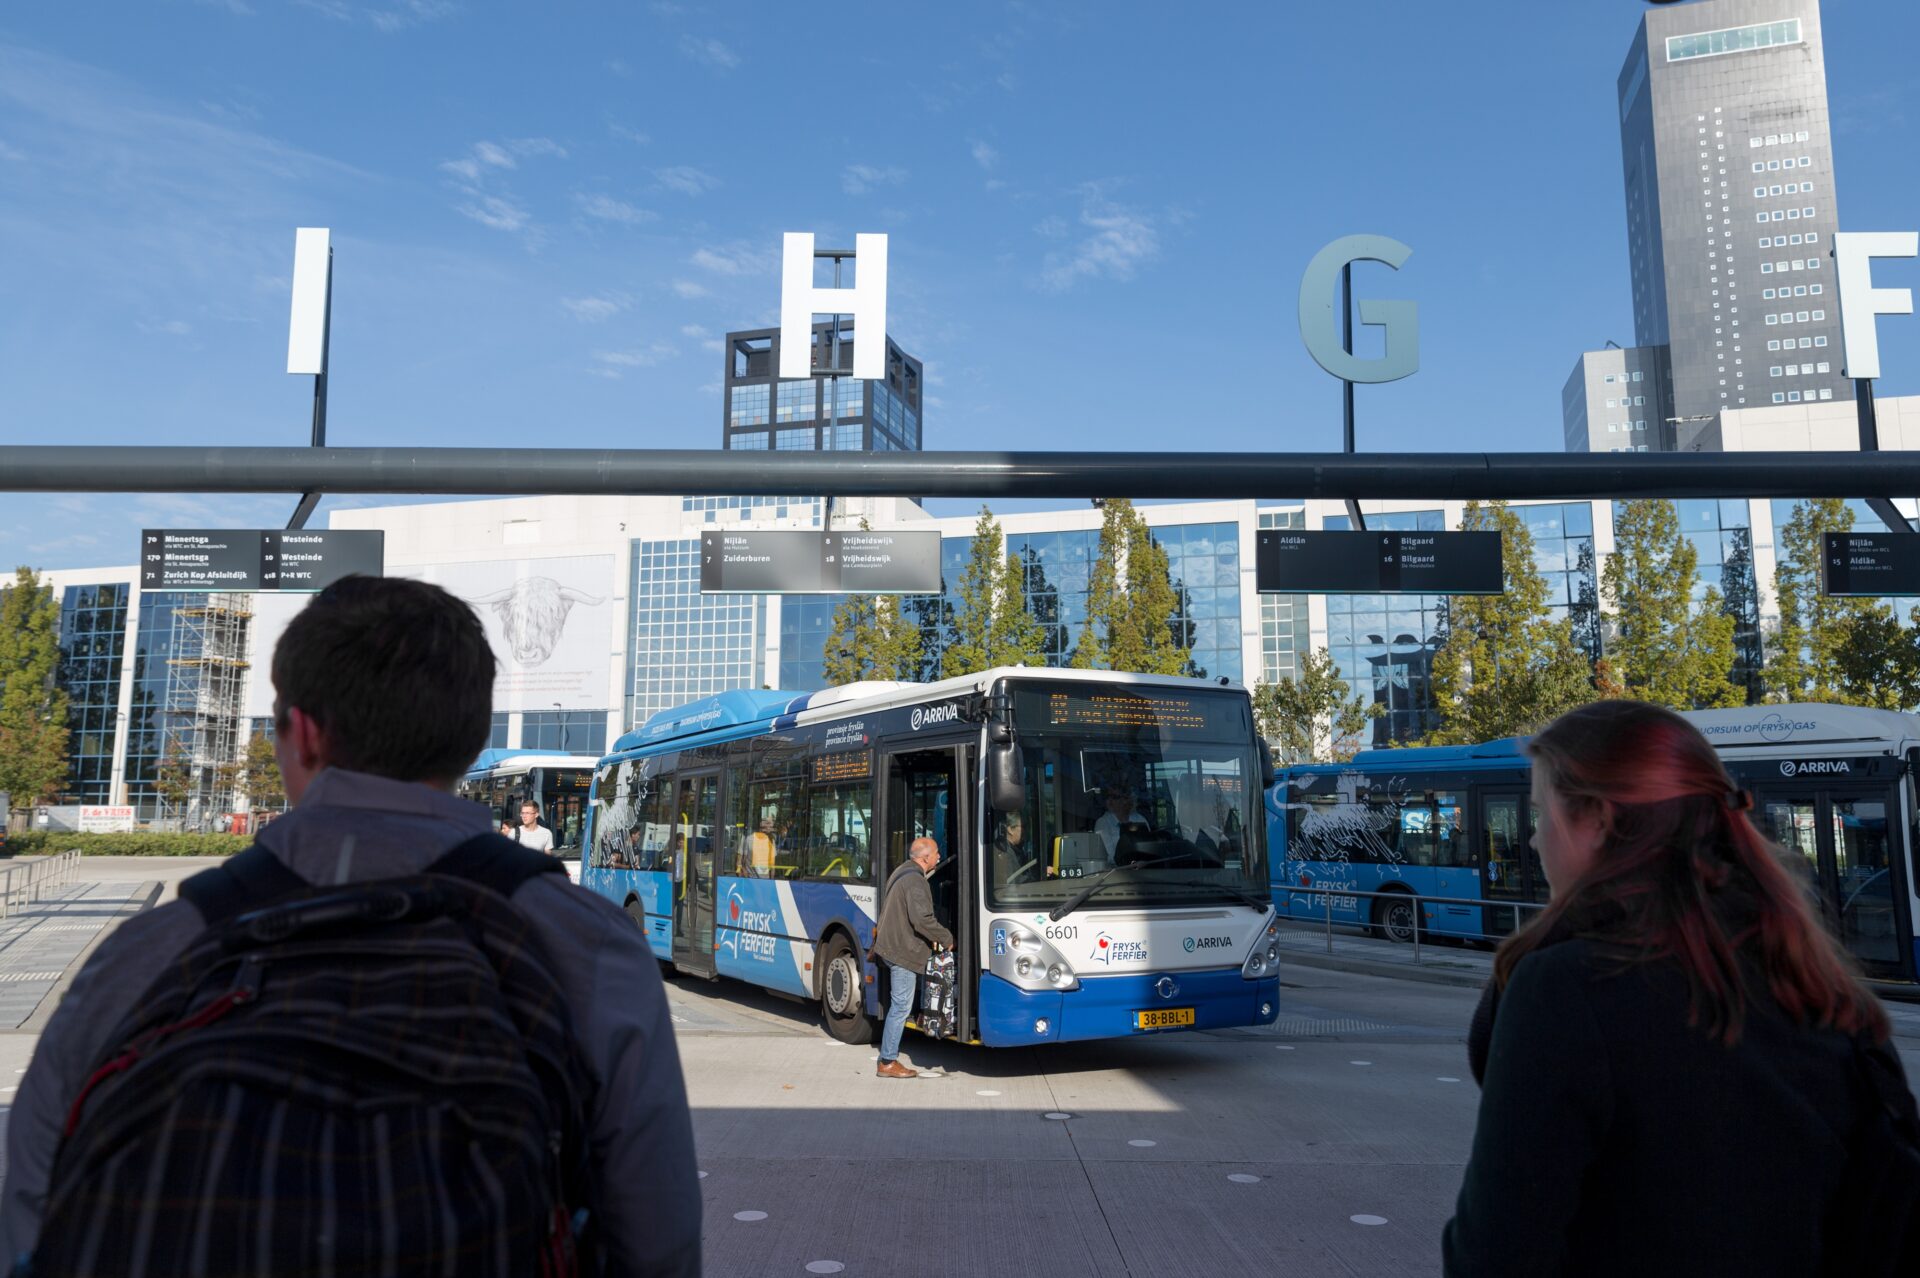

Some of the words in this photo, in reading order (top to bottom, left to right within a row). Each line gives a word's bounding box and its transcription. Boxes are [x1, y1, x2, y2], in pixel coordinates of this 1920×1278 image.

[779, 232, 888, 379] H
[1298, 233, 1419, 384] G
[1833, 231, 1919, 378] F
[165, 536, 208, 544] Minnertsga
[724, 537, 747, 545] Nijlân
[843, 537, 893, 545] Vrijheidswijk
[1401, 537, 1434, 545] Bilgaard
[1849, 539, 1873, 547] Nijlân
[843, 555, 891, 563] Vrijheidswijk
[1402, 555, 1434, 563] Bilgaard
[1850, 557, 1876, 565] Aldlân
[207, 571, 247, 580] Afsluitdijk
[922, 704, 959, 724] ARRIVA
[1698, 726, 1741, 735] UORSUM
[1743, 725, 1759, 733] OP
[1760, 721, 1792, 732] FRYSK
[1794, 721, 1816, 730] GAS
[1798, 761, 1850, 773] ARRIVA
[1061, 868, 1082, 878] 603
[1315, 881, 1351, 892] FRYSK
[743, 911, 772, 933] FRYSK
[1045, 925, 1078, 939] 6601
[740, 932, 776, 956] FERFIER
[1112, 942, 1141, 951] FRYSK
[1196, 936, 1232, 949] ARRIVA
[1112, 951, 1147, 961] FERFIER
[1144, 1011, 1189, 1025] 38-BBL-1
